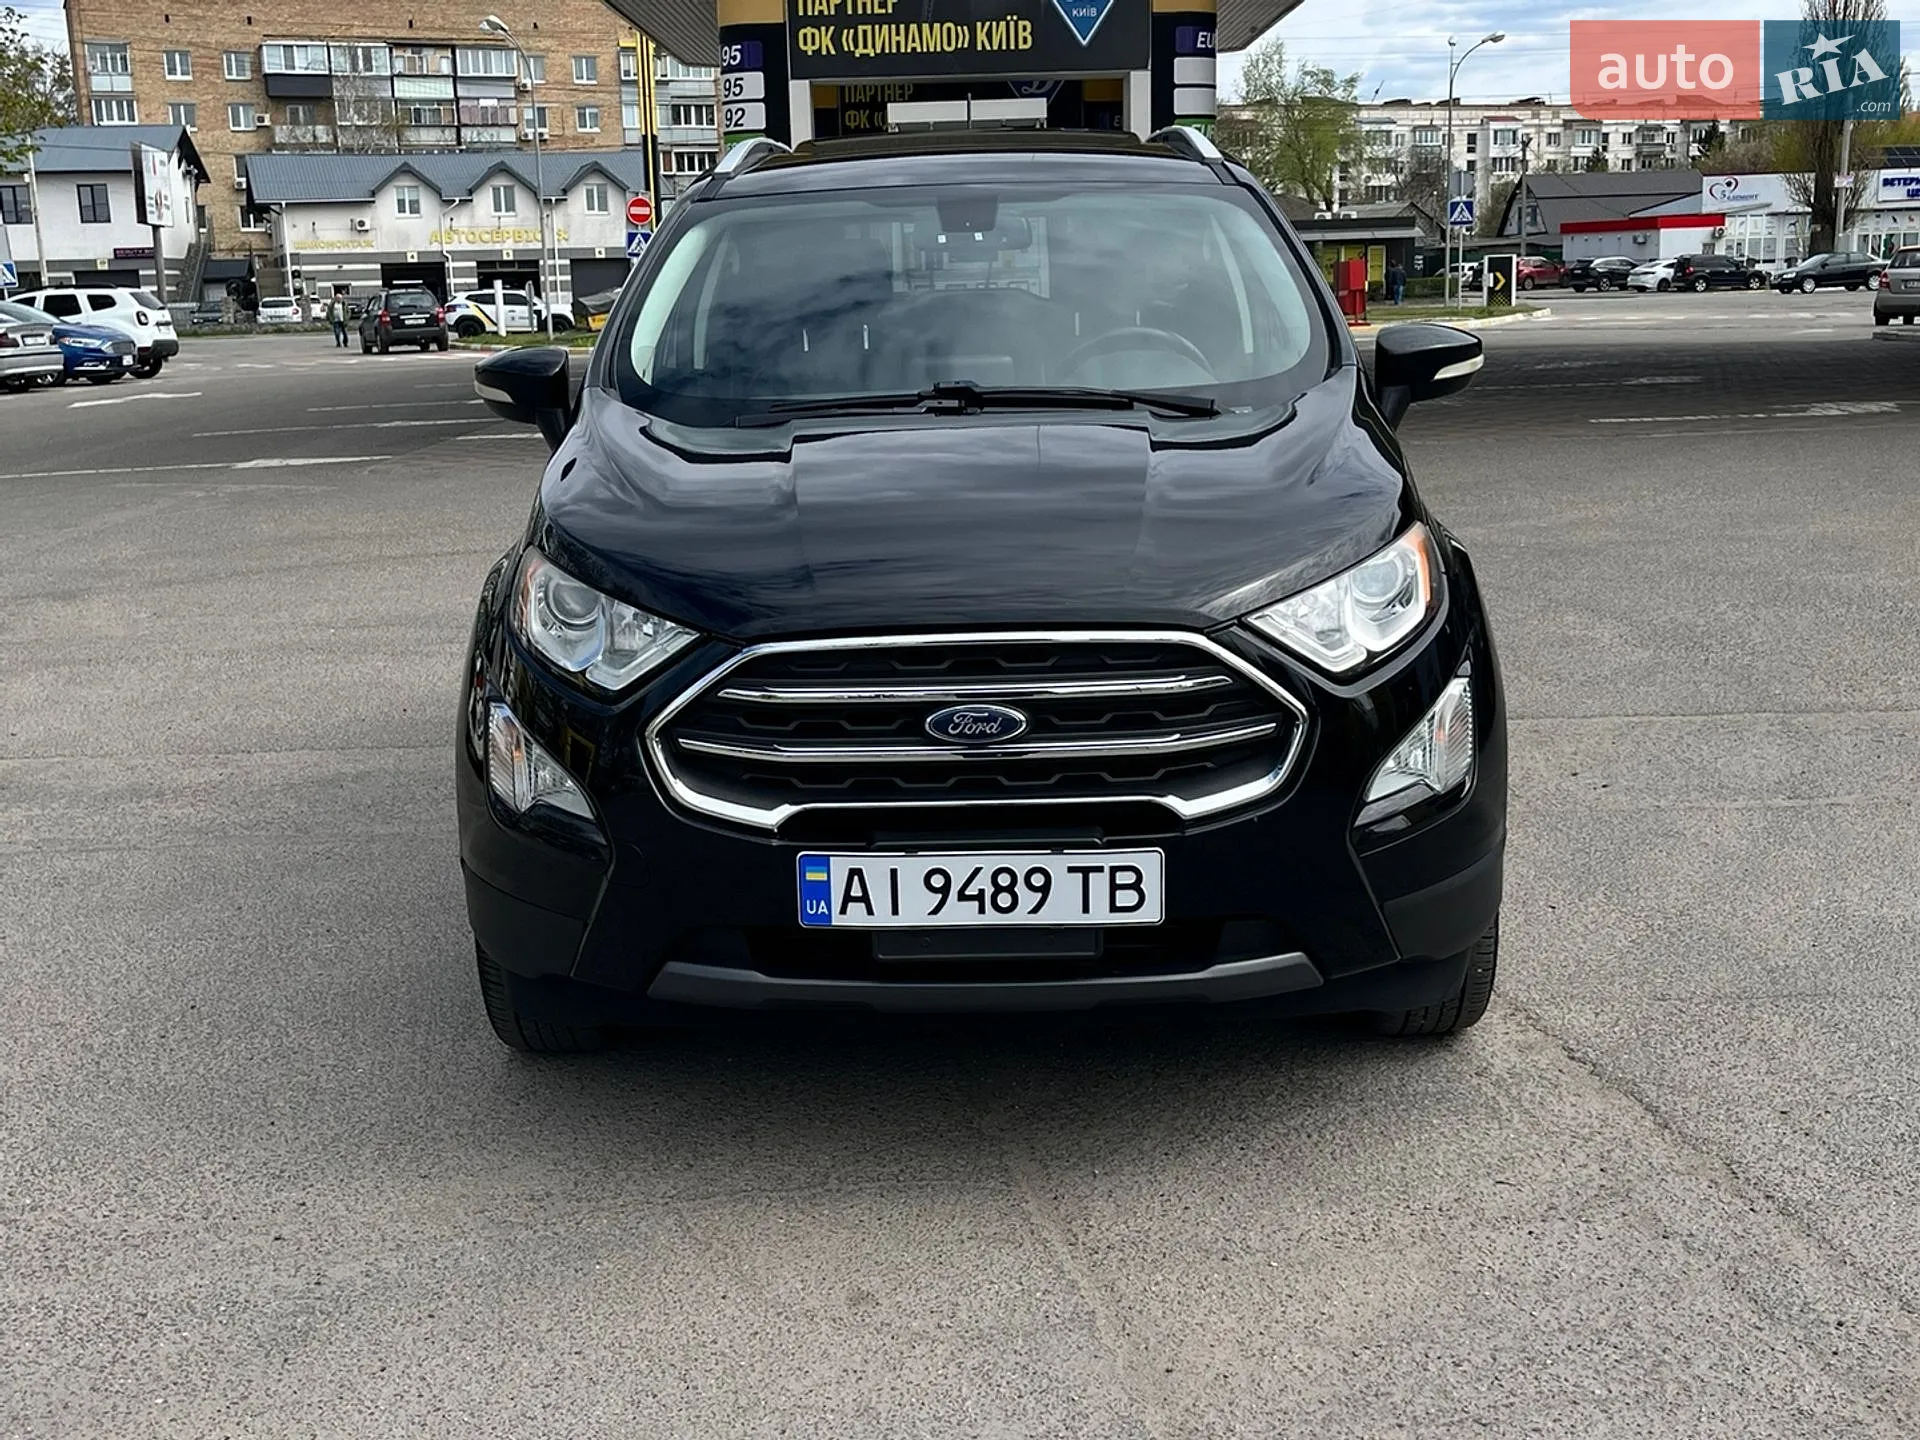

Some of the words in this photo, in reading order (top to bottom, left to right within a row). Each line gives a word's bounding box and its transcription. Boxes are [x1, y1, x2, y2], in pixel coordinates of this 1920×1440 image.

[798, 26, 836, 56] ФК
[841, 22, 970, 58] «ДИНАМО»
[975, 14, 1033, 51] КИЇВ
[722, 45, 741, 66] 95
[724, 77, 744, 98] 95
[726, 108, 746, 128] 92
[845, 109, 870, 129] ФК
[948, 712, 1001, 734] Ford
[923, 866, 1052, 915] 9489
[1067, 864, 1146, 914] TB
[806, 900, 828, 915] UA
